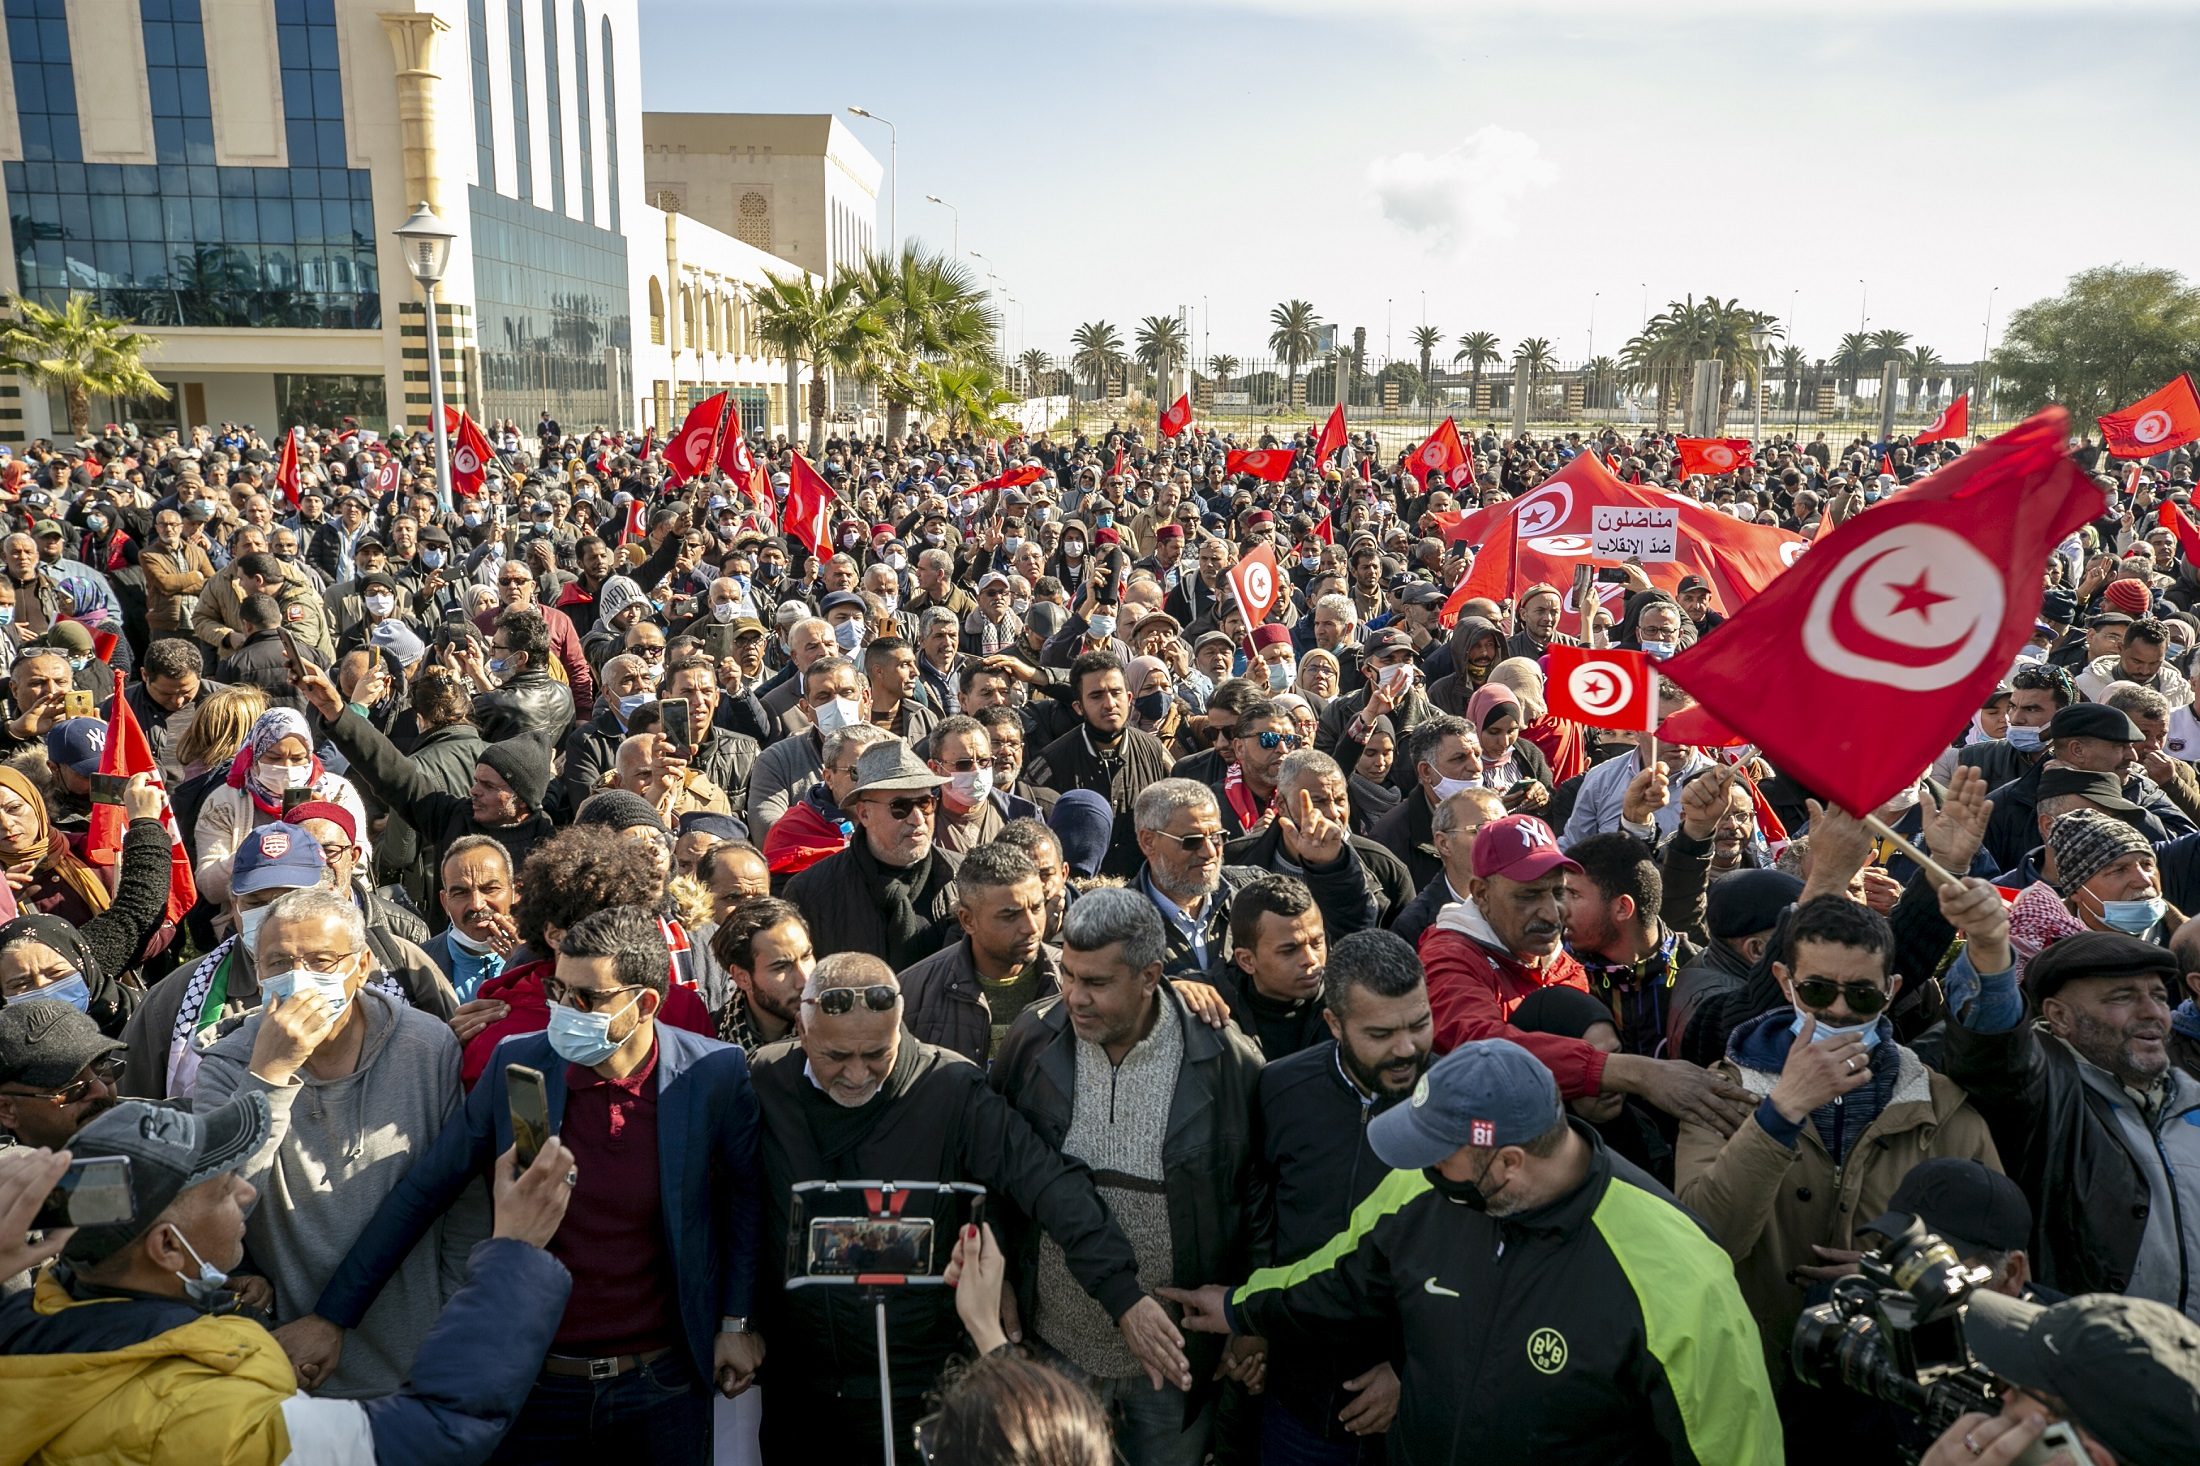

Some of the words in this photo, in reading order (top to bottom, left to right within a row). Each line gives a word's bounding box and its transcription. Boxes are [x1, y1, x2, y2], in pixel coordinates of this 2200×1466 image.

[1598, 510, 1672, 532] مناضلون
[1515, 817, 1553, 848] NY
[1473, 1127, 1494, 1147] 81
[1532, 1332, 1563, 1365] BVB
[1537, 1355, 1550, 1368] 09
